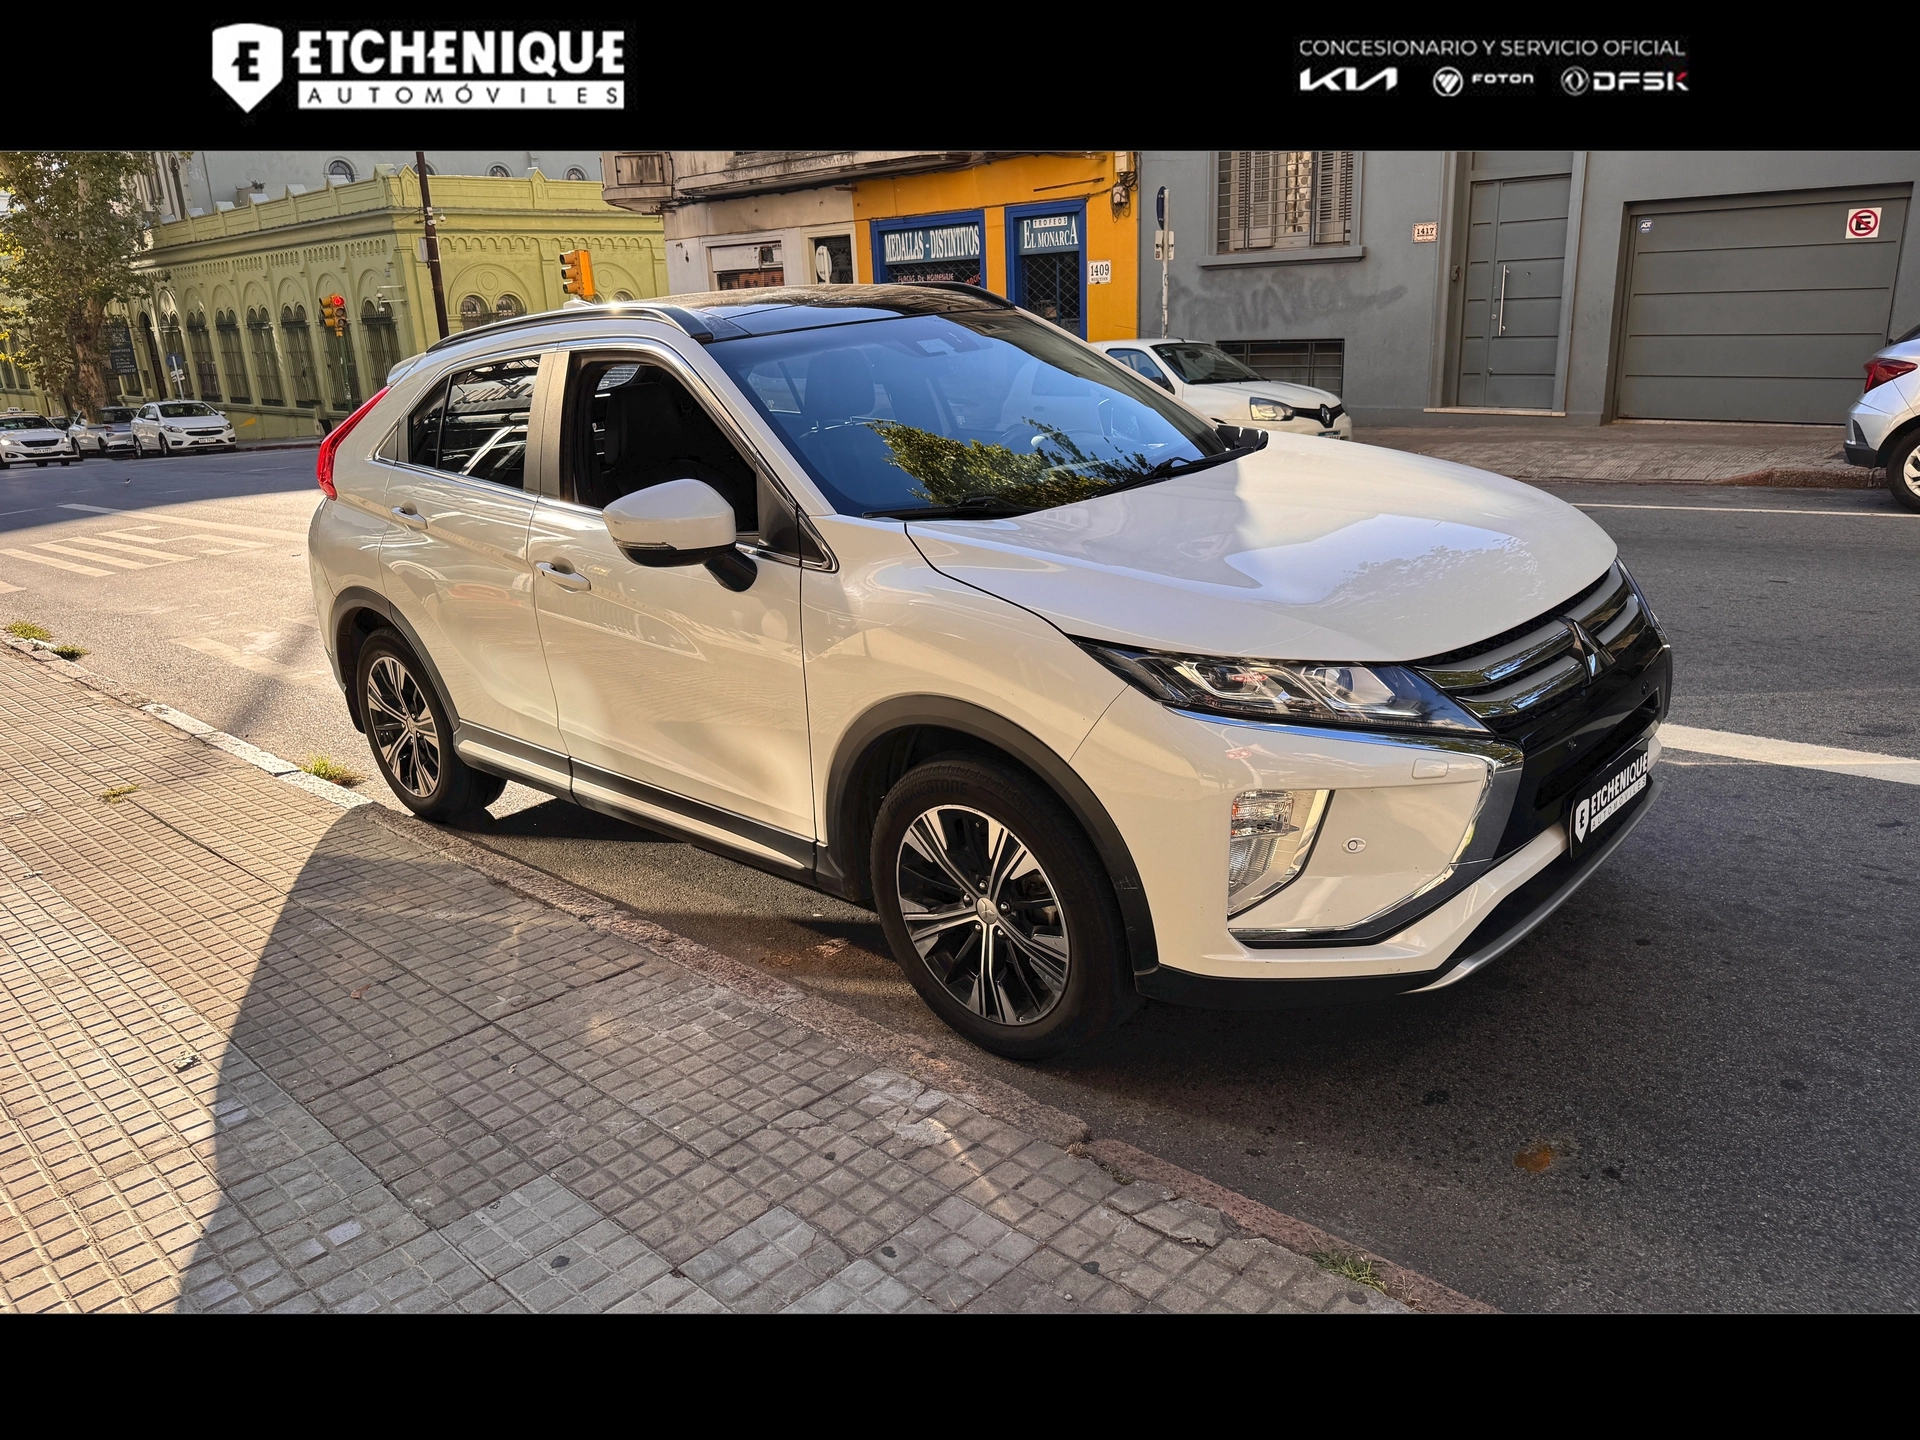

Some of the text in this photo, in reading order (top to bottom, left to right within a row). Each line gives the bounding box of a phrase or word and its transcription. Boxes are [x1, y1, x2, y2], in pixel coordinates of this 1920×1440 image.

[1034, 218, 1067, 227] TROFEOS
[1037, 215, 1079, 248] MONARCA
[884, 231, 924, 262] MEDALLAS
[929, 225, 980, 259] DISTINTIVOS
[1090, 263, 1110, 277] 1409
[1590, 751, 1648, 817] ETCHENIQUE
